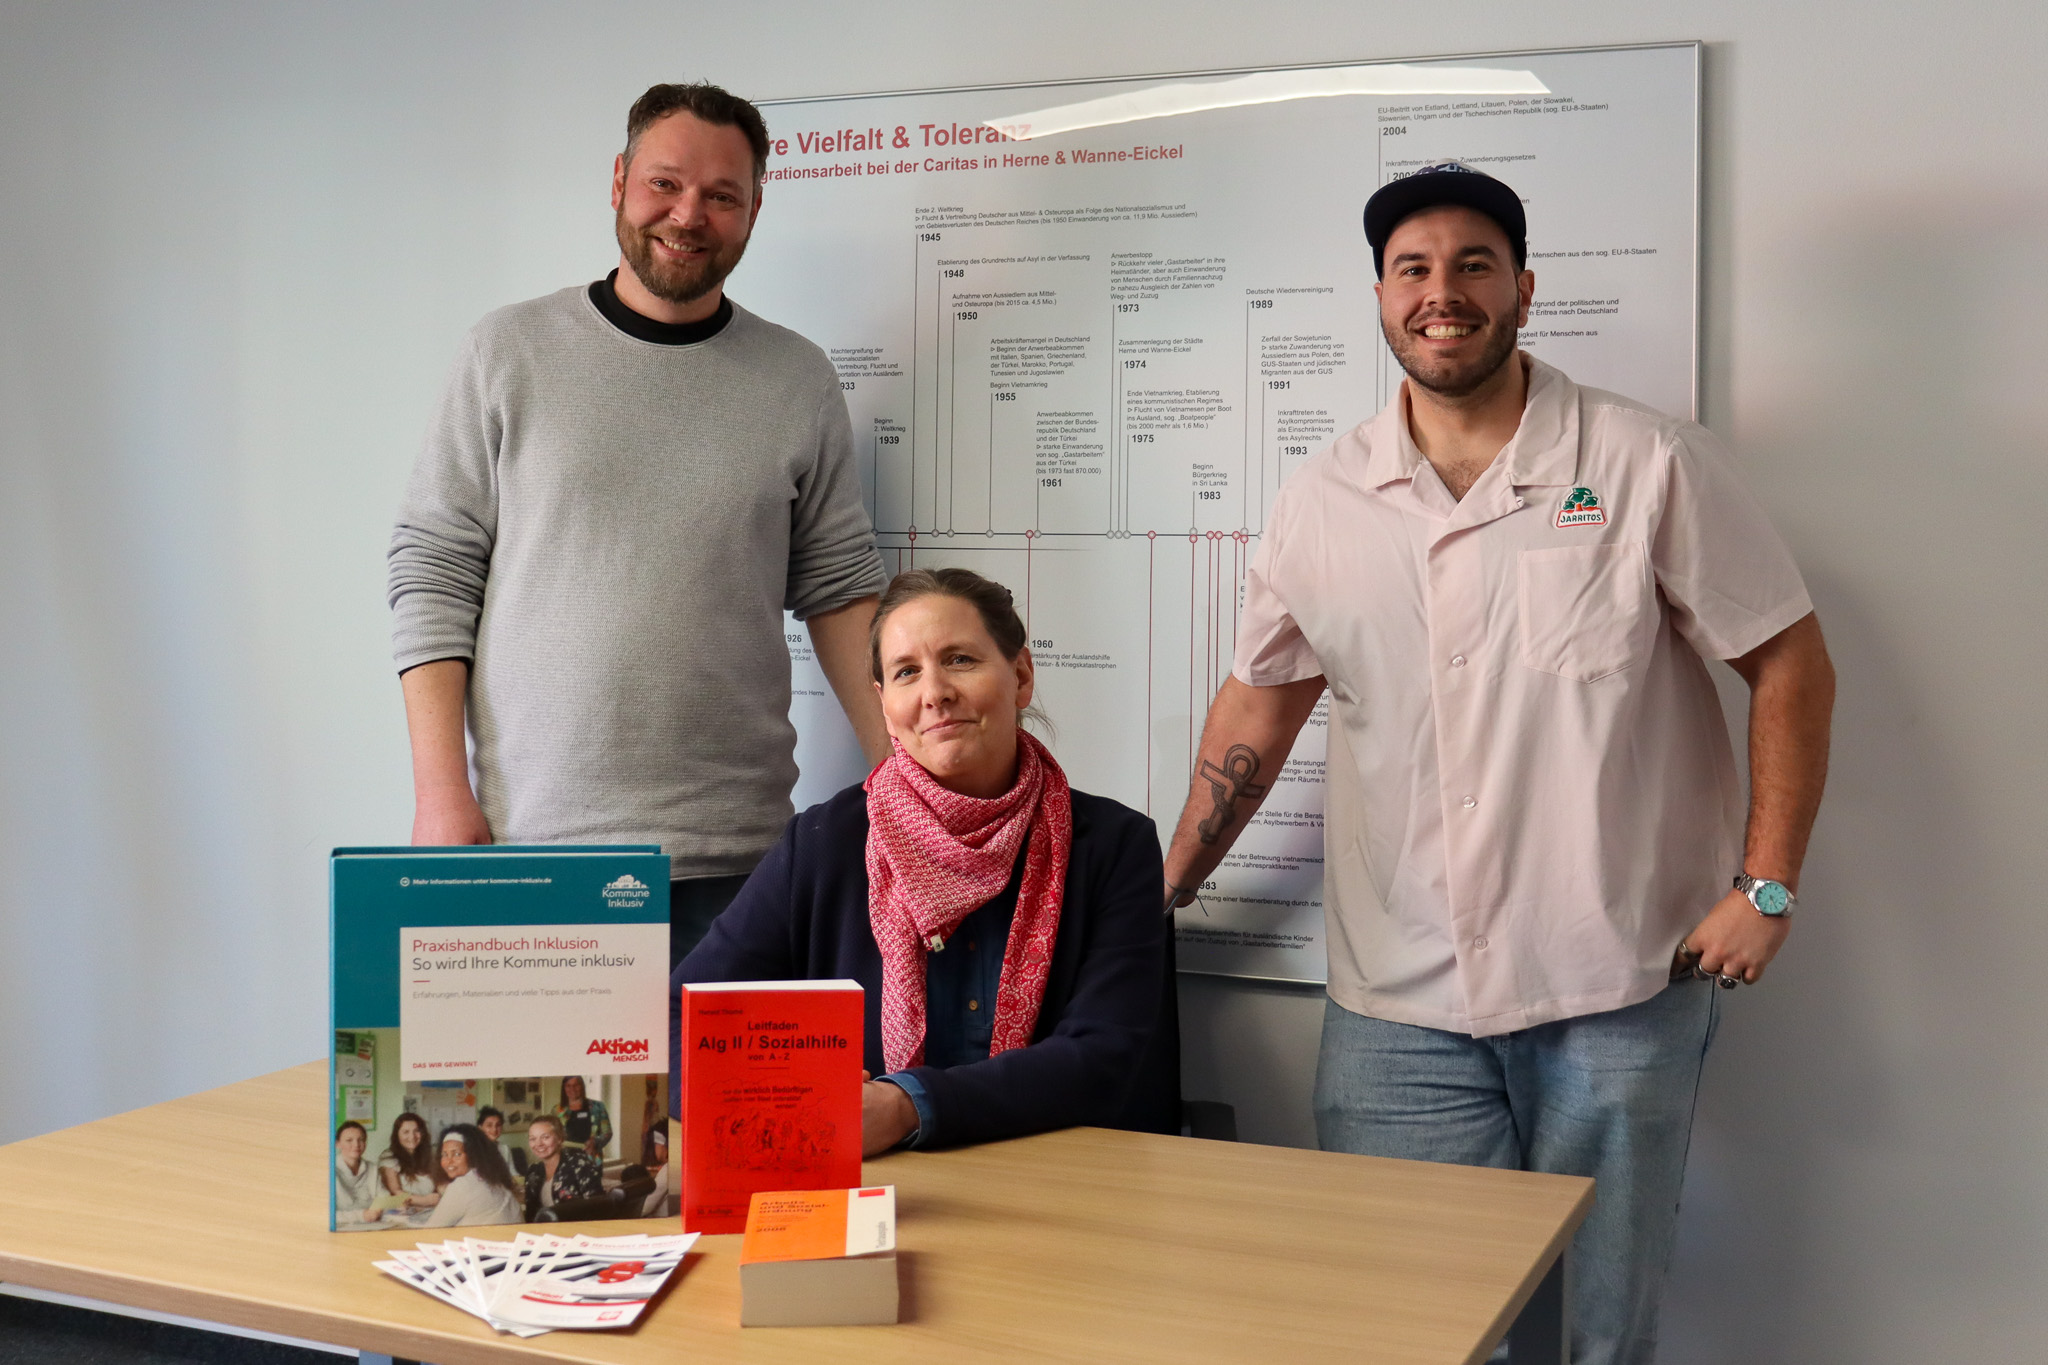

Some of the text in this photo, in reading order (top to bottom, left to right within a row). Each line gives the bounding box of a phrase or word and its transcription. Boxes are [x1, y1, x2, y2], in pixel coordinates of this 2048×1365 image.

[1377, 105, 1410, 114] EU-Beitritt
[1424, 103, 1450, 112] Estland,
[1480, 100, 1507, 109] Litauen,
[1508, 99, 1529, 108] Polen,
[1377, 113, 1412, 122] Slowenien,
[1413, 112, 1437, 121] Ungarn
[1464, 108, 1511, 117] Tschechischen
[1512, 107, 1541, 116] Republik
[1542, 106, 1559, 115] (sog.
[1560, 104, 1609, 114] EU-8-Staaten)
[1383, 127, 1406, 136] 2004
[797, 128, 883, 154] Vielfalt
[892, 126, 910, 148] &
[919, 123, 1032, 147] Toleranz
[868, 161, 889, 175] bei
[895, 160, 919, 173] der
[924, 157, 978, 172] Caritas
[984, 155, 997, 168] in
[1003, 153, 1049, 167] Herne
[1055, 151, 1066, 164] &
[1072, 144, 1183, 163] Wanne-Eickel
[1460, 154, 1536, 163] Zuwanderungsgesetzes
[920, 233, 941, 242] 1945
[1532, 250, 1566, 258] Menschen
[1611, 248, 1657, 256] EU-8-Staaten
[944, 269, 964, 278] 1948
[1276, 287, 1333, 296] Wiedervereinigung
[1117, 304, 1139, 312] 1973
[1250, 300, 1273, 309] 1989
[1531, 300, 1556, 309] ufgrund
[1569, 299, 1605, 308] politischen
[957, 312, 978, 320] 1950
[1293, 334, 1331, 343] Sowjetunion
[1288, 343, 1331, 352] Zuwanderung
[1124, 360, 1146, 369] 1974
[1316, 359, 1346, 368] jüdischen
[840, 382, 855, 390] 933
[1268, 381, 1290, 390] 1991
[995, 393, 1016, 401] 1955
[1143, 390, 1184, 398] Vietnamkrieg,
[1185, 389, 1219, 397] Etablierung
[1196, 397, 1223, 405] Regimes
[1277, 418, 1335, 426] Asylkompromisses
[1287, 426, 1334, 434] Einschränkung
[879, 436, 900, 444] 1939
[1132, 435, 1154, 443] 1975
[1289, 434, 1322, 443] Asylrechts
[1284, 447, 1307, 455] 1993
[1192, 472, 1227, 480] Bürgerkrieg
[1041, 479, 1062, 487] 1961
[1198, 492, 1221, 500] 1983
[1560, 514, 1601, 523] JARRITOS
[1032, 640, 1053, 648] 1960
[1199, 882, 1216, 890] 983
[602, 888, 649, 898] Kommune
[608, 898, 644, 908] Inklusiv
[1239, 896, 1290, 906] Italienerberatung
[413, 937, 598, 952] Praxishandbuch Inklusion
[413, 954, 635, 970] So wird Ihre Kommune inklusiv
[413, 991, 460, 1000] Erfahrungen,
[540, 988, 559, 998] Tipps
[748, 1022, 798, 1030] Leitfaden
[699, 1036, 726, 1053] Alg
[748, 1036, 753, 1048] /
[759, 1035, 847, 1049] Sozialhilfe
